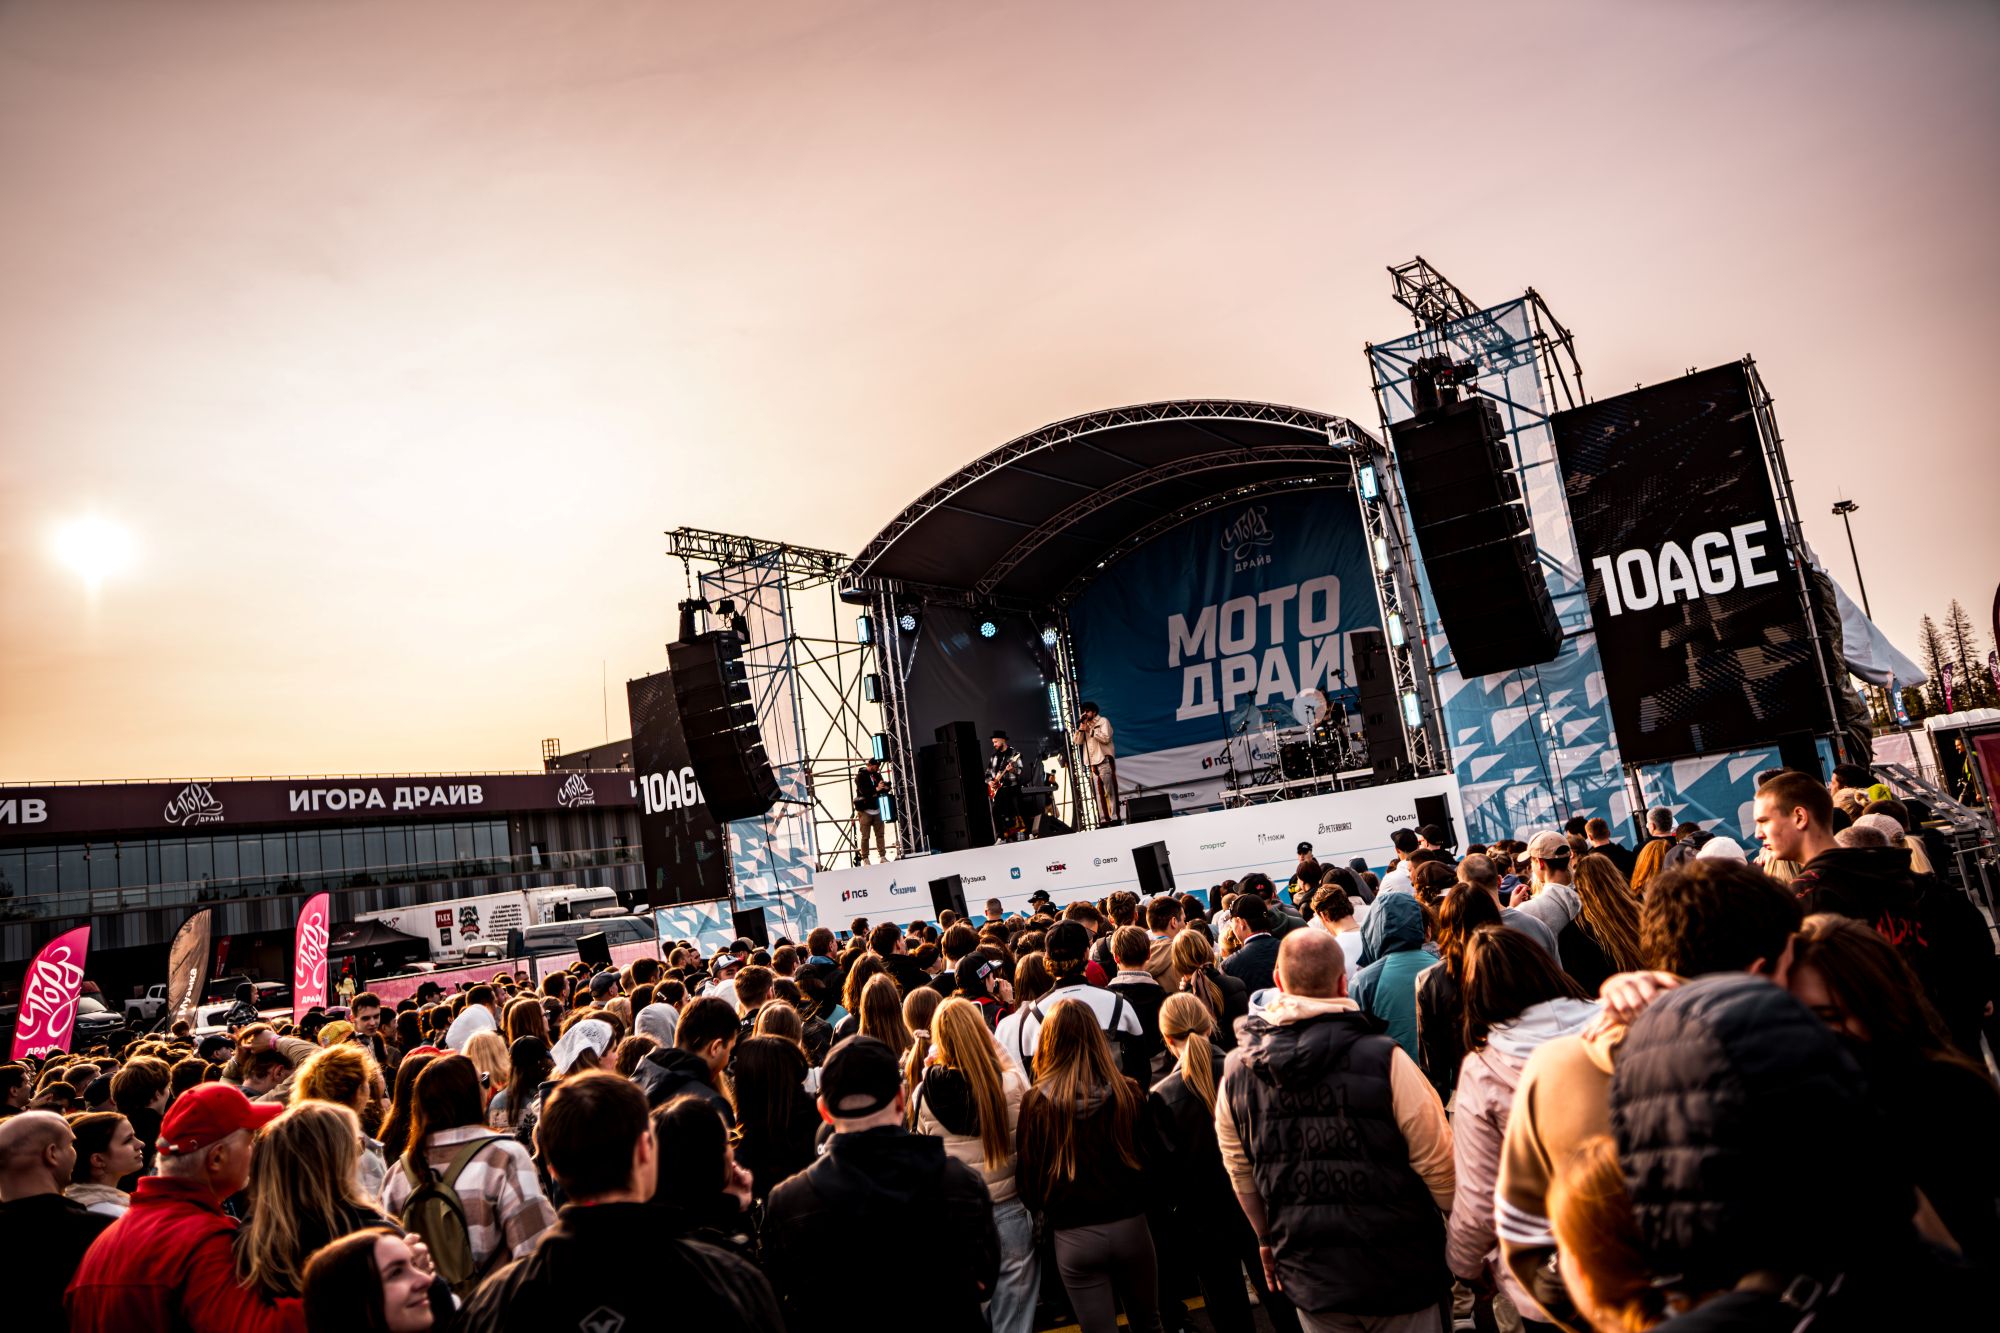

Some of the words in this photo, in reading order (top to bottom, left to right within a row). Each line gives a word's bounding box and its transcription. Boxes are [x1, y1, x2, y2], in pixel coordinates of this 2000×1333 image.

[1235, 554, 1272, 573] ДРАЙВ
[1592, 520, 1779, 617] 10AGE
[1168, 575, 1340, 668] МОТО
[289, 788, 386, 812] ИГОРА
[393, 785, 484, 811] ДРАЙВ
[200, 814, 226, 823] ДРАЙВ
[1386, 813, 1417, 824] Quto.ru
[852, 889, 868, 899] ПСБ
[437, 913, 451, 923] FLEX
[178, 968, 197, 1016] Музыка
